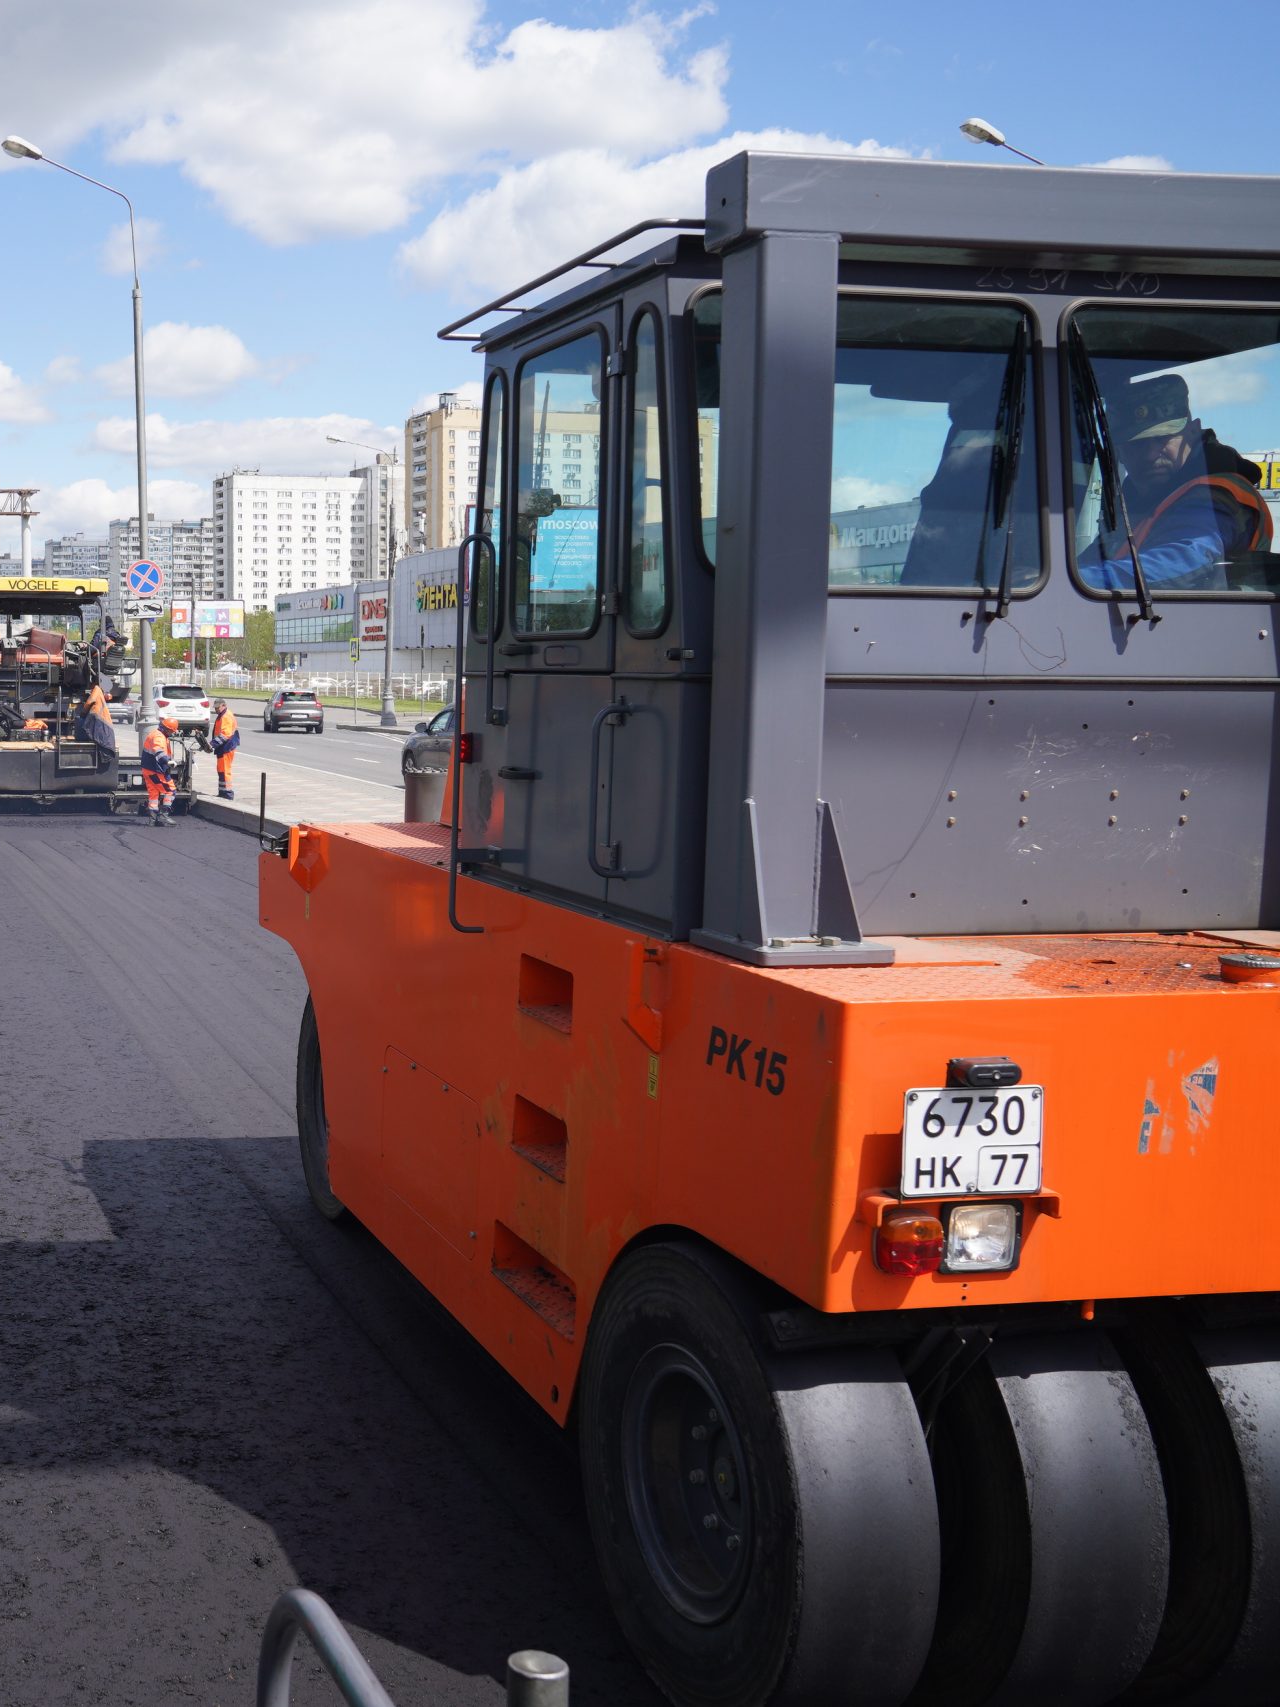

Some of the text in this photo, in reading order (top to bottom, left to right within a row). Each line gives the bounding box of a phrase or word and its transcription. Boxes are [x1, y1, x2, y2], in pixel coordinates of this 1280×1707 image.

[361, 598, 387, 620] DNS
[422, 583, 458, 610] ЛЕНТА
[922, 1095, 1025, 1139] 6730
[915, 1153, 1029, 1189] НК 77
